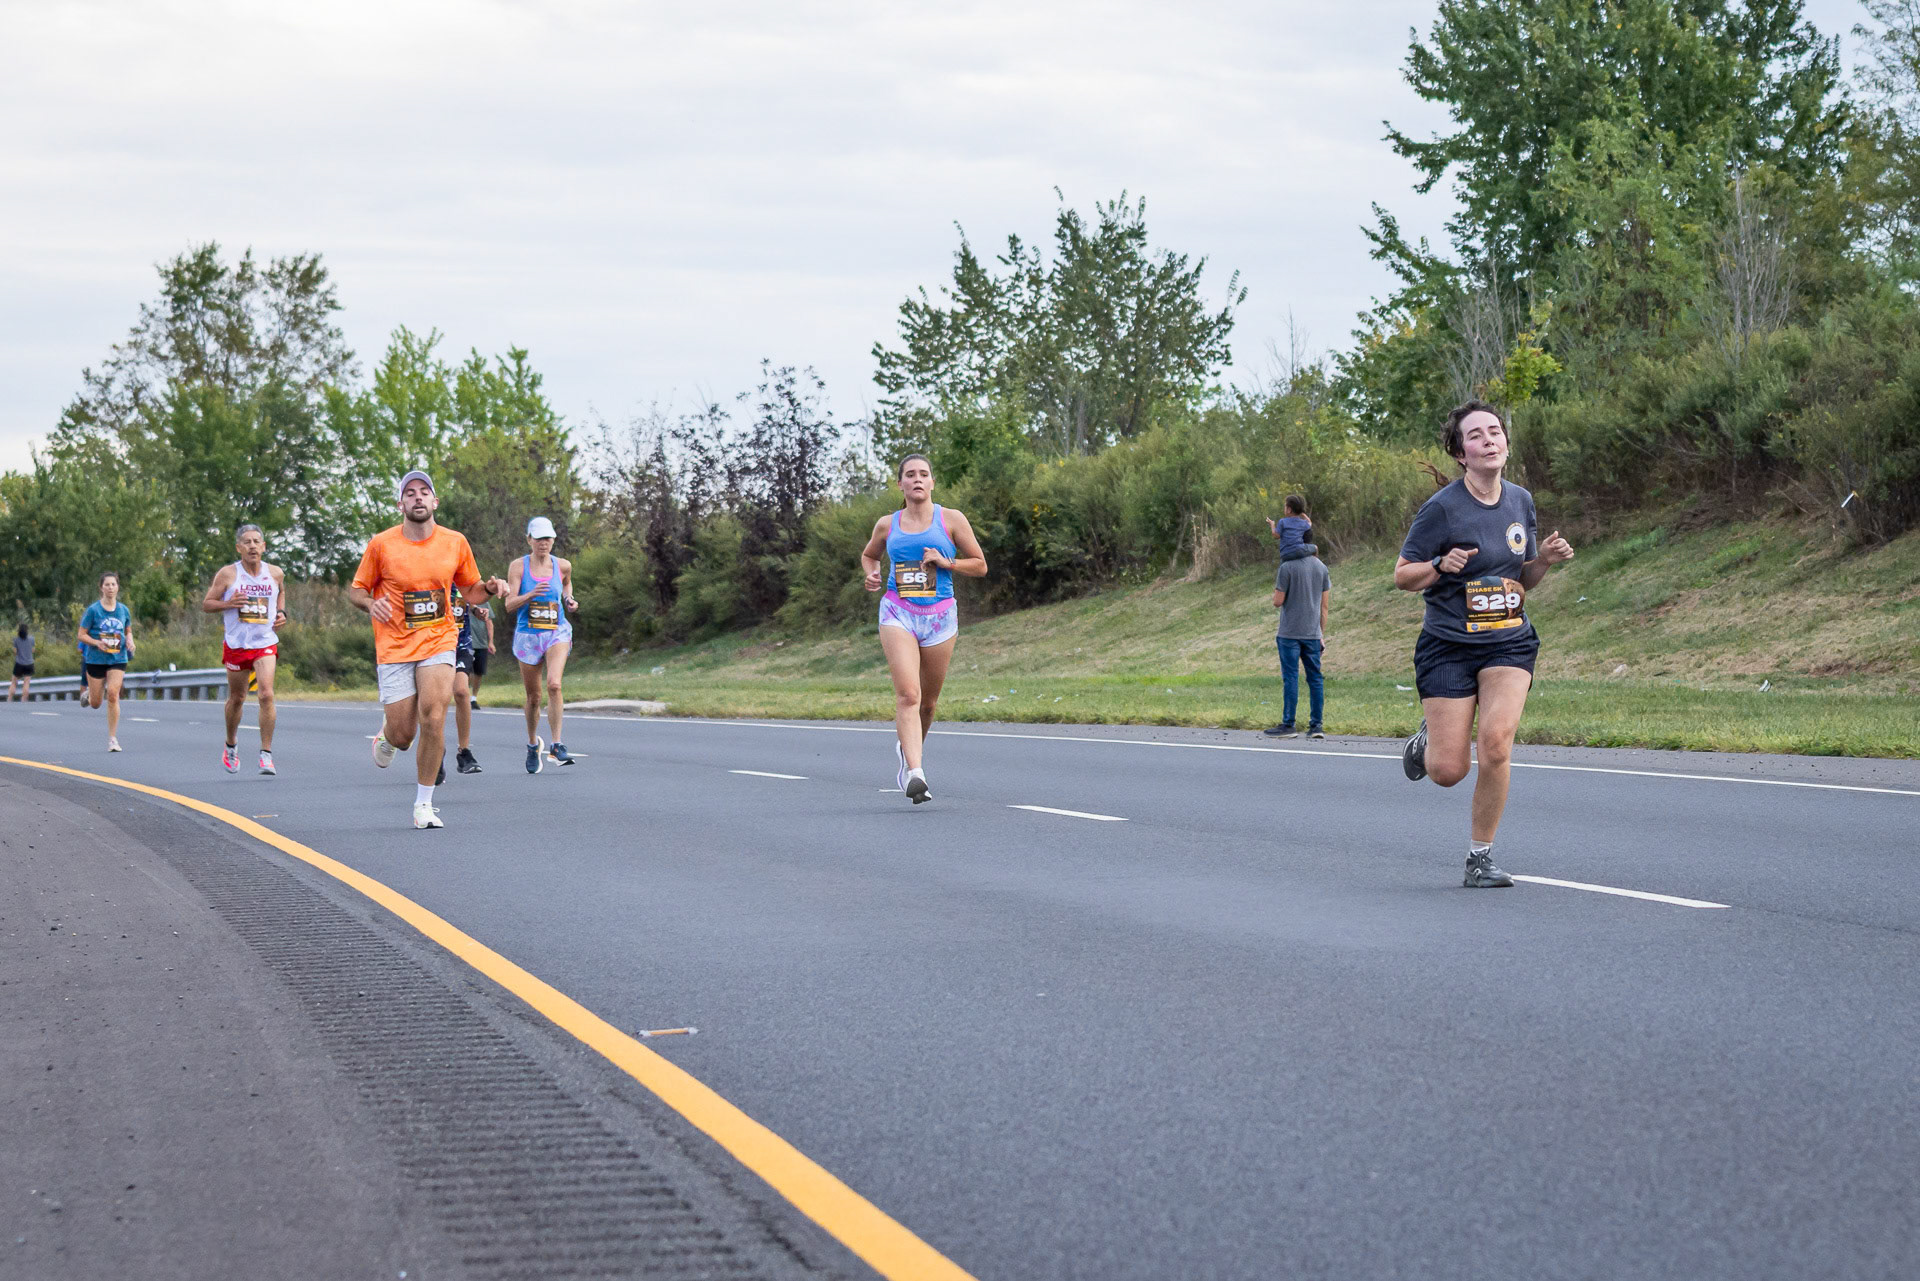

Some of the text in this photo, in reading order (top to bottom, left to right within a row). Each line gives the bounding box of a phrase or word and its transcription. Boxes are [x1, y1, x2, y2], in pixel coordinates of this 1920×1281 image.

[902, 572, 928, 584] 56
[240, 584, 273, 593] LEONIA
[1471, 592, 1521, 611] 329
[413, 602, 438, 615] 80
[530, 609, 558, 619] 348
